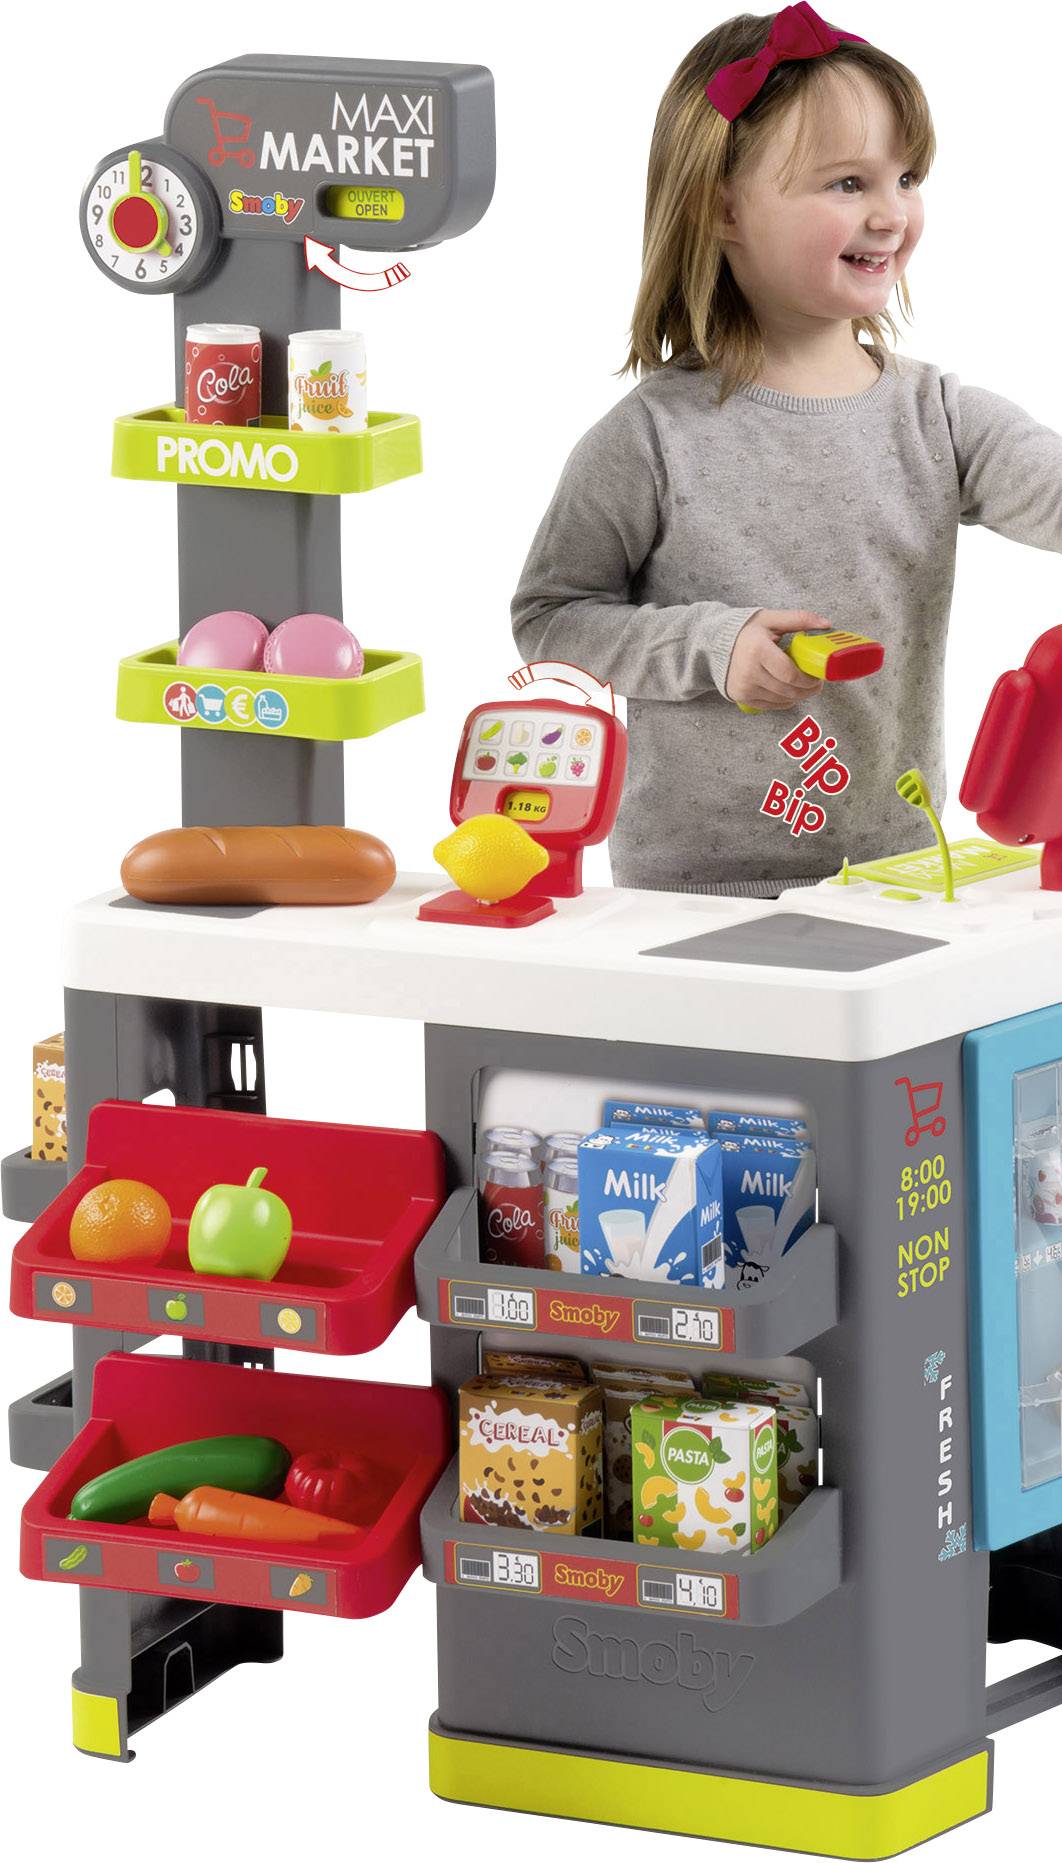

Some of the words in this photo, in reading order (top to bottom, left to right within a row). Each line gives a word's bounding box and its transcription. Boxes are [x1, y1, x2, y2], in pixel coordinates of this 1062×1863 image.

[332, 91, 433, 135] MAXI
[259, 130, 435, 179] MARKET
[113, 170, 125, 184] 11
[165, 179, 170, 192] 1
[97, 185, 112, 199] 10
[176, 194, 185, 208] 2
[348, 190, 395, 204] OUVERT
[92, 204, 104, 225] 9
[229, 188, 305, 224] Smoby
[354, 202, 388, 216] OPEN
[180, 214, 192, 236] 3
[95, 234, 104, 248] 8
[174, 243, 184, 256] 4
[111, 255, 119, 268] 7
[135, 258, 147, 279] 6
[160, 260, 168, 273] 5
[197, 364, 253, 403] Cola
[294, 369, 350, 399] Fruit
[298, 398, 333, 419] juice
[157, 435, 299, 483] PROMO
[507, 801, 532, 812] 1.18
[533, 804, 547, 814] KG
[635, 1106, 674, 1117] Milk
[739, 1117, 778, 1128] Milk
[625, 1133, 679, 1144] Milk
[744, 1138, 784, 1149] Milk
[741, 1169, 794, 1198] Milk
[901, 1154, 945, 1192] 8:00
[604, 1168, 668, 1203] Milk
[896, 1179, 951, 1222] 19:00
[487, 1207, 536, 1238] Cola
[548, 1208, 579, 1233] Fru
[700, 1199, 721, 1228] Milk
[553, 1231, 579, 1251] juic
[898, 1226, 949, 1269] NON
[897, 1256, 951, 1298] STOP
[549, 1300, 620, 1333] Smoby
[479, 1419, 560, 1447] CEREAL
[667, 1447, 710, 1467] PASTA
[756, 1440, 773, 1459] PASTA
[937, 1374, 953, 1529] FRESH
[554, 1563, 625, 1597] Smoby
[551, 1614, 755, 1714] Smoby
